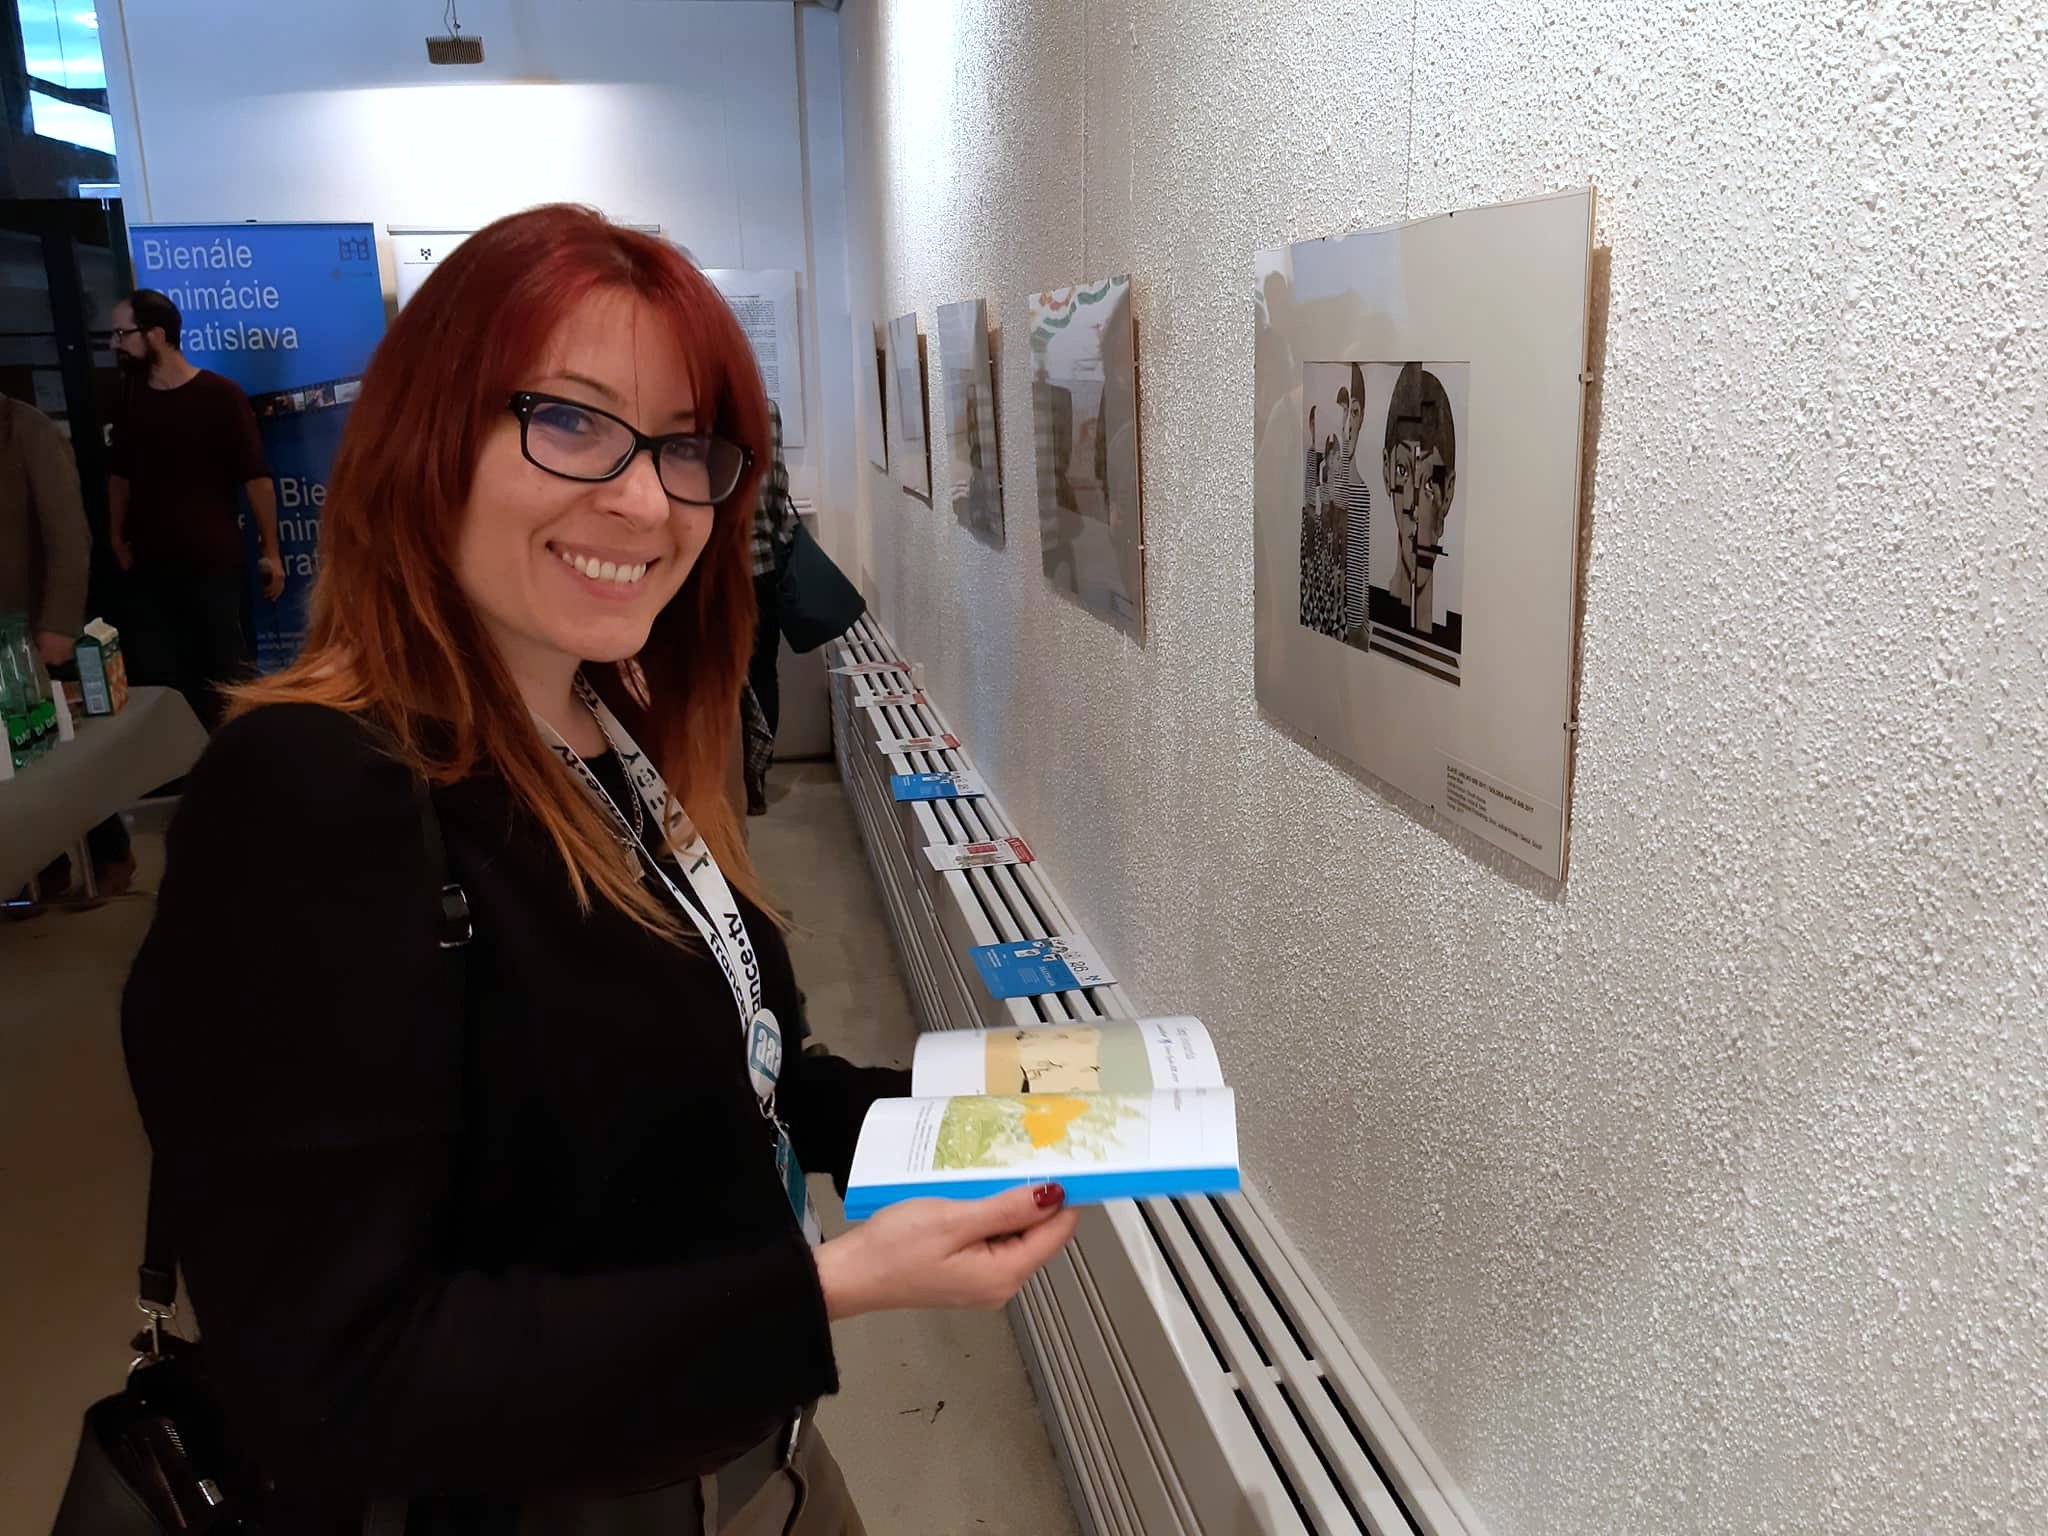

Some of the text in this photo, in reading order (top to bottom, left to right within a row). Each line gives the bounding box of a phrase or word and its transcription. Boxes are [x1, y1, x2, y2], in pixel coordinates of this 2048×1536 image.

[143, 238, 253, 269] Bienále
[154, 279, 280, 311] nimácie
[180, 320, 299, 351] ratislava
[279, 476, 327, 508] Bie
